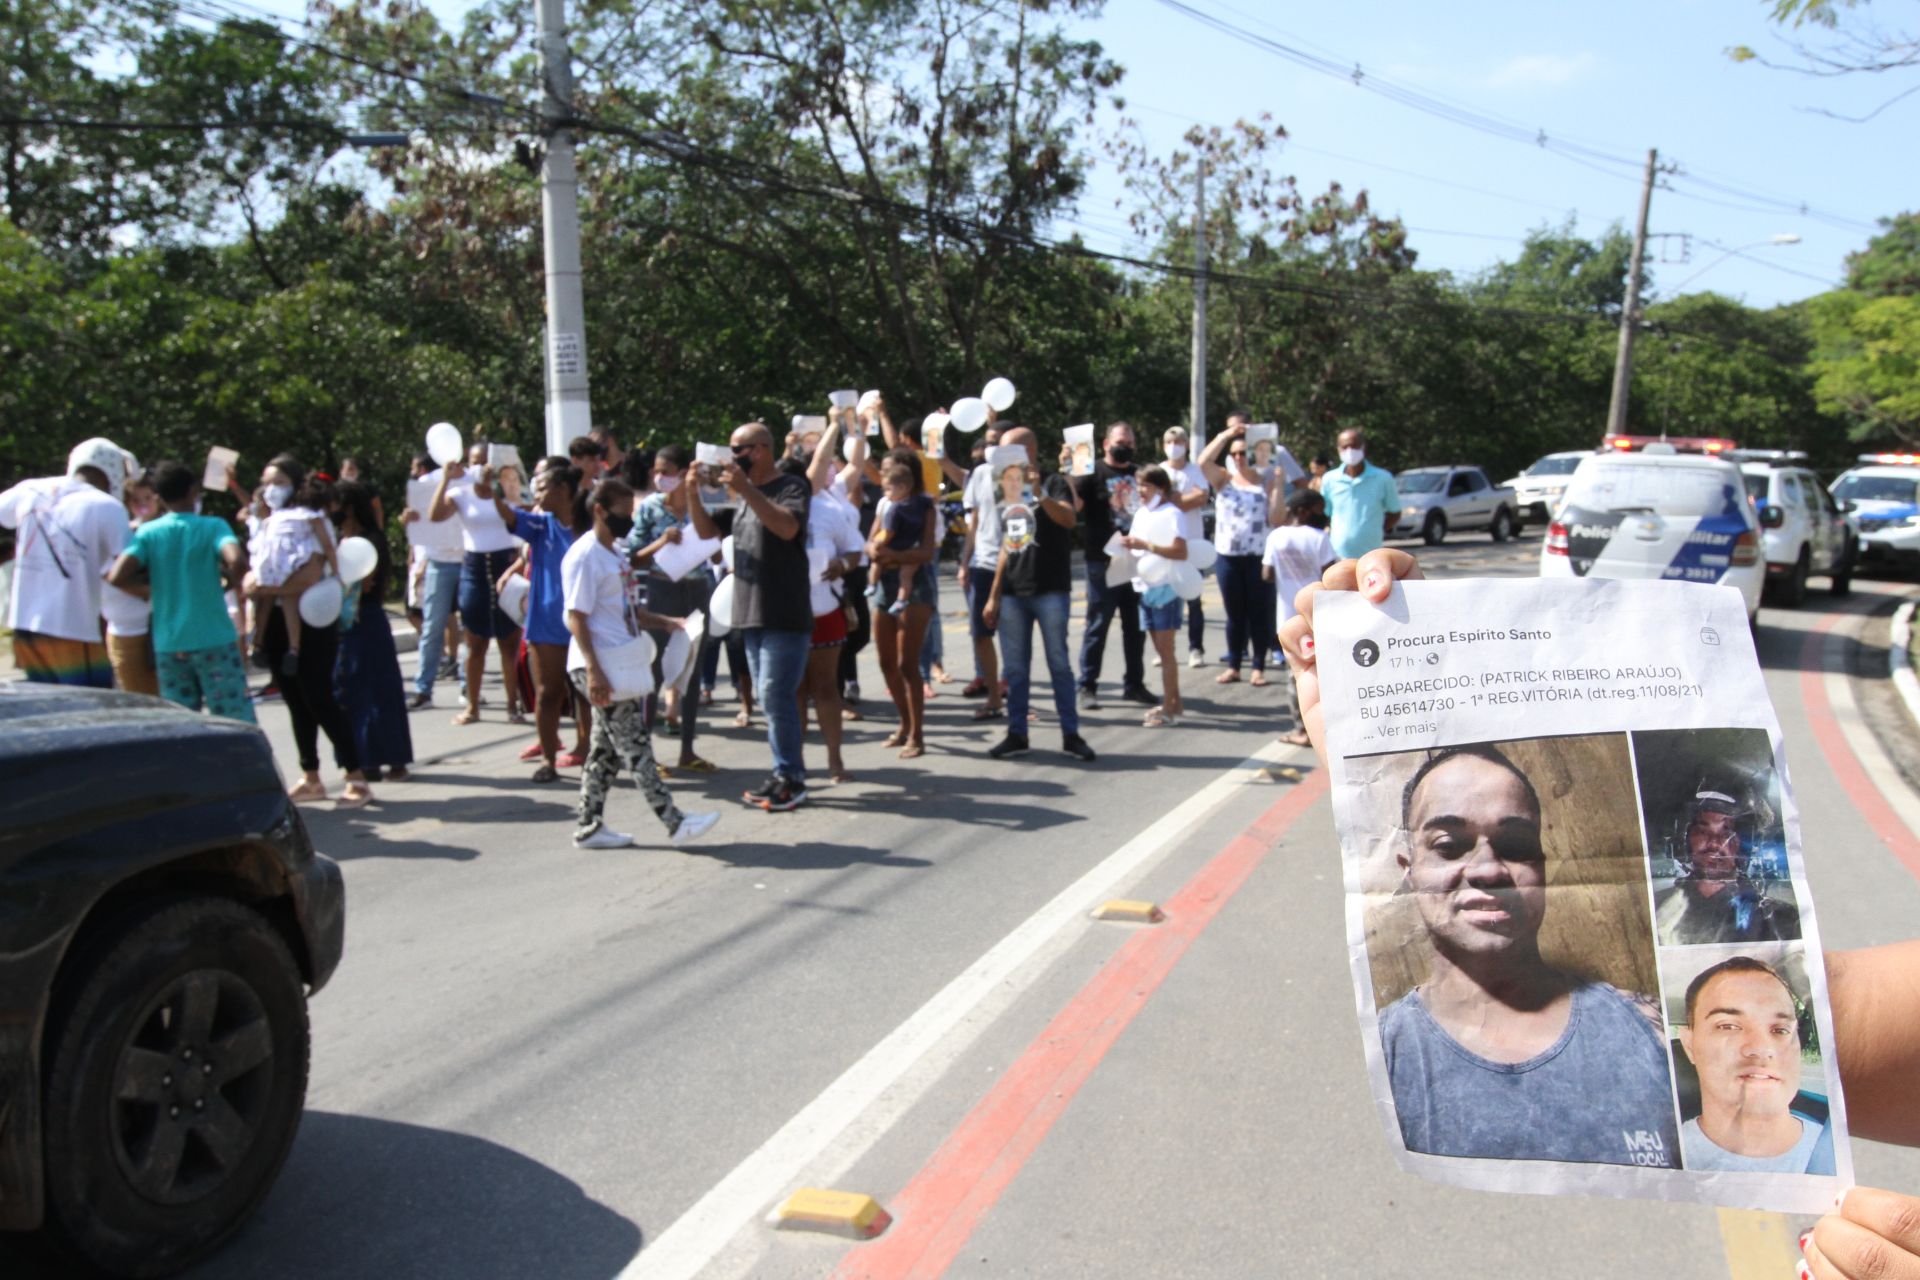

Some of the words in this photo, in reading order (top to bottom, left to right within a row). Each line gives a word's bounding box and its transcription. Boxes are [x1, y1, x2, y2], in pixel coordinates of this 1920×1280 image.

[1387, 634, 1445, 649] Procura
[1449, 629, 1505, 643] Espírito
[1509, 629, 1552, 640] Santo
[1390, 657, 1402, 669] 17
[1406, 656, 1414, 667] h
[1358, 675, 1475, 700] DESAPARECIDO:
[1480, 670, 1547, 688] (PATRICK
[1552, 668, 1611, 681] RIBEIRO
[1616, 665, 1682, 681] ARAÚJO)
[1361, 706, 1380, 719] BU
[1383, 697, 1455, 717] 45614730
[1488, 686, 1583, 705] REG.VITÓRIA
[1587, 684, 1704, 702] (dt.reg.11/08/21)
[1377, 724, 1400, 738] Ver
[1405, 721, 1437, 735] mais
